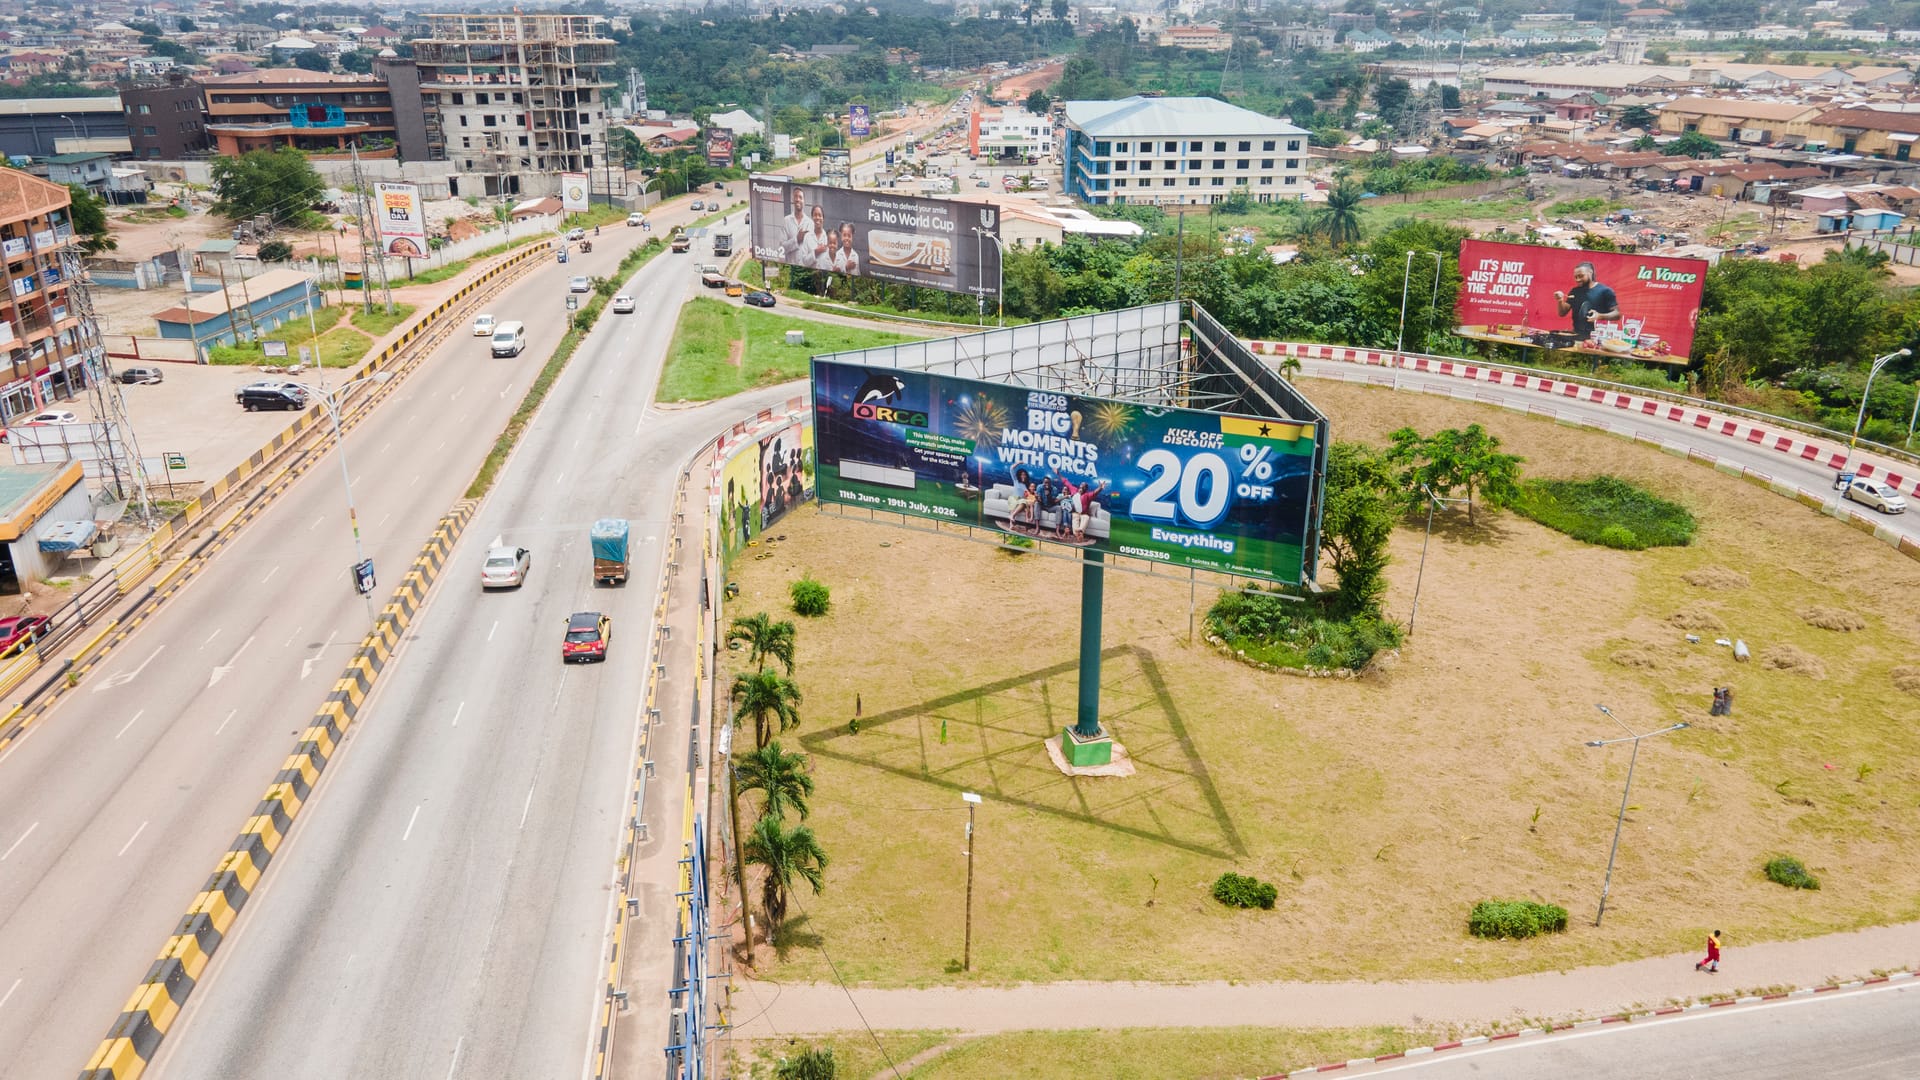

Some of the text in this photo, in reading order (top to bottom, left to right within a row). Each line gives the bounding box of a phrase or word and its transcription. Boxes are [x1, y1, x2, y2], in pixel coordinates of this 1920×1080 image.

[752, 182, 782, 194] Pepsodent
[871, 199, 892, 208] Promise
[900, 202, 918, 212] defend
[919, 206, 932, 214] your
[868, 208, 954, 232] Fa No World Cup
[755, 245, 765, 256] Do
[766, 247, 778, 257] the
[778, 246, 785, 258] 2
[1480, 259, 1524, 273] IT'S NOT
[1637, 265, 1697, 283] la Vonce
[1467, 270, 1534, 286] JUST ABOUT
[1467, 282, 1530, 299] THE JOLLOF,
[1028, 391, 1068, 406] 2026
[856, 405, 924, 425] ORCA
[1028, 409, 1070, 433] BIG
[1162, 435, 1224, 450] DISCOUNT
[1168, 428, 1224, 442] KICK OFF
[1001, 428, 1098, 461] MOMENTS
[998, 446, 1098, 478] WITH ORCA
[1130, 443, 1272, 522] 20 %
[1236, 484, 1274, 500] OFF
[839, 489, 856, 500] 11th
[857, 493, 880, 503] June
[888, 498, 906, 508] 19th
[908, 502, 931, 514] July,
[932, 506, 958, 517] 2026.
[1152, 528, 1234, 553] Everything
